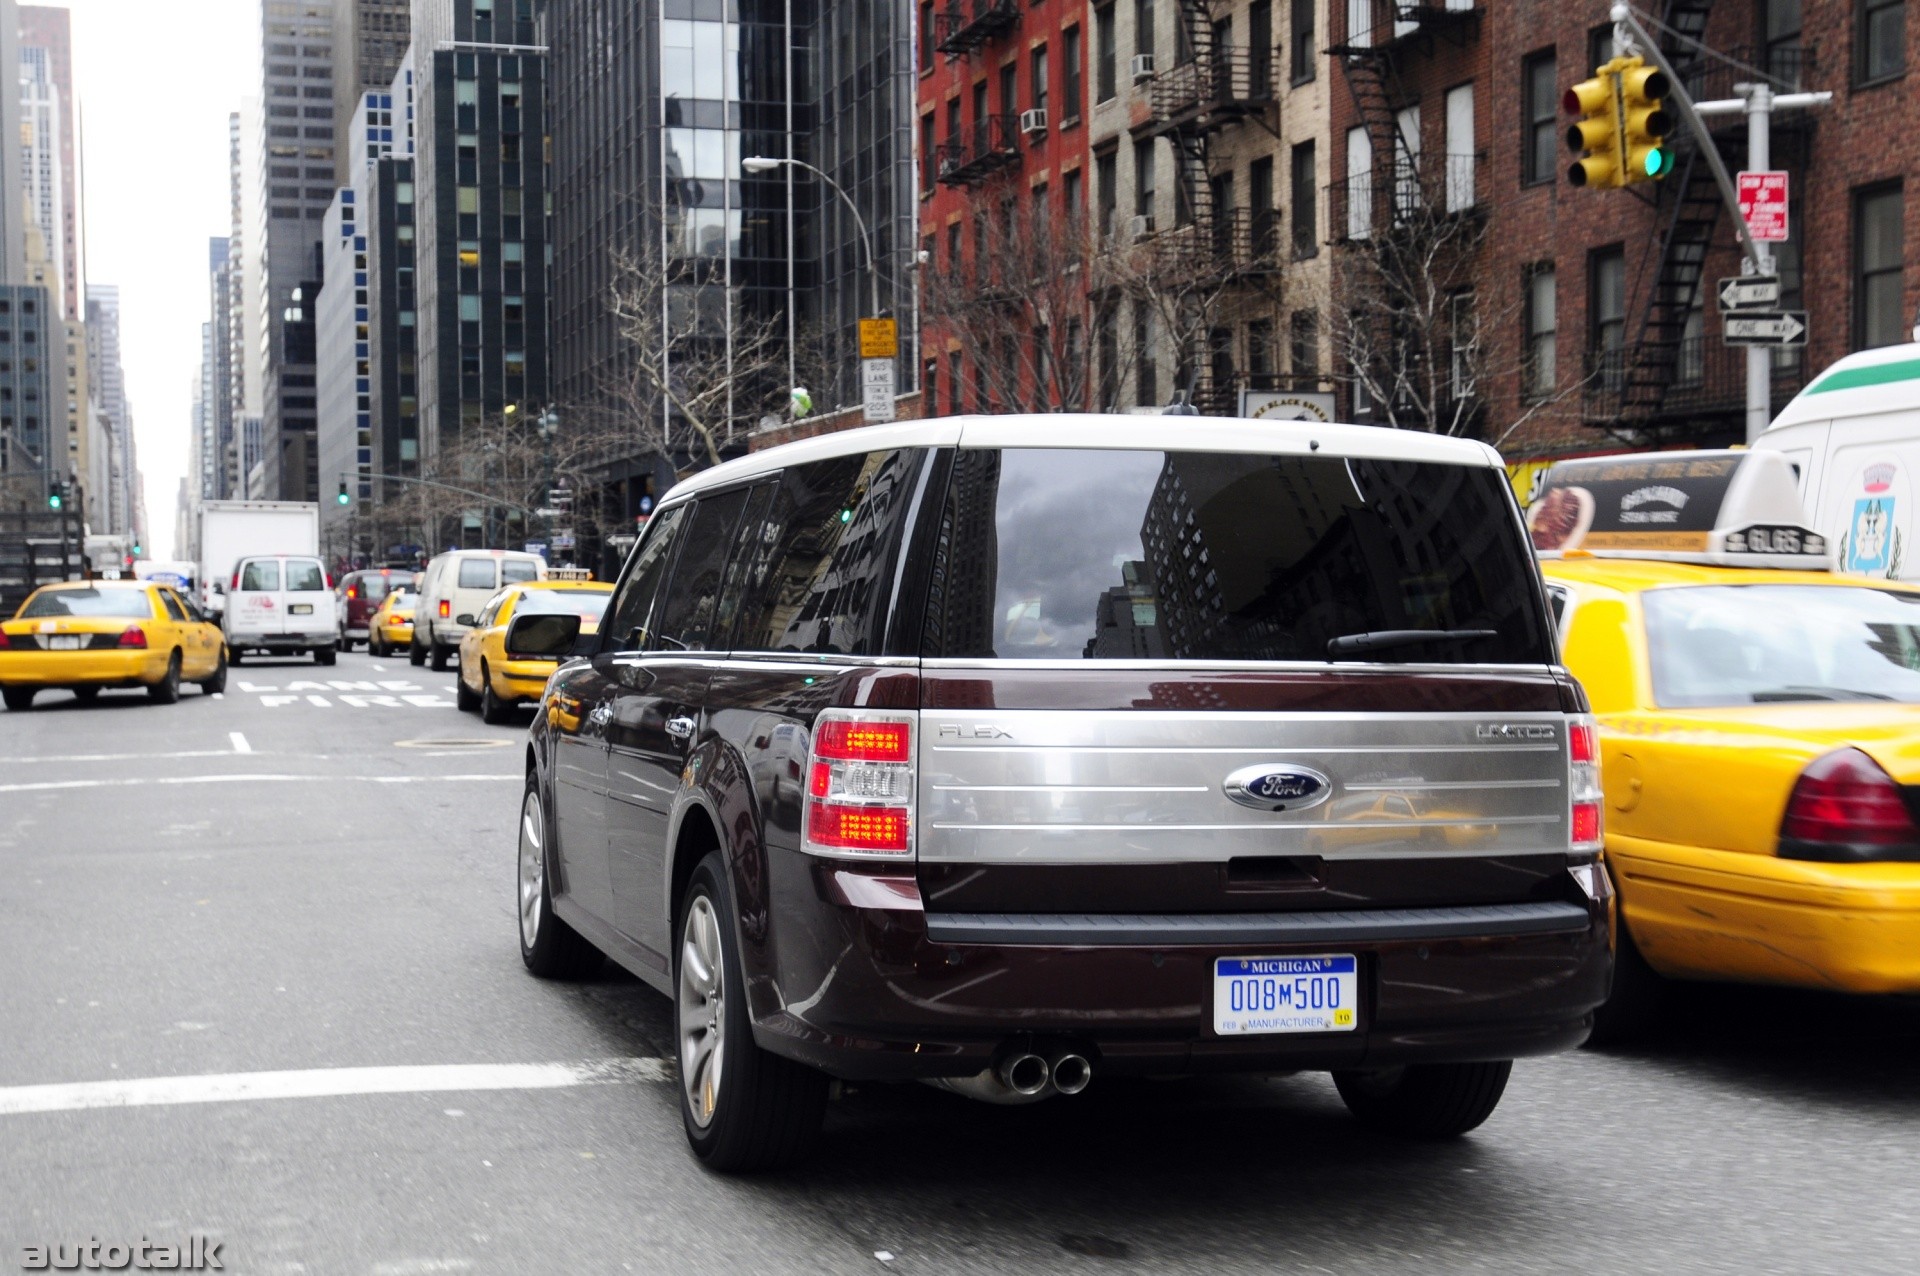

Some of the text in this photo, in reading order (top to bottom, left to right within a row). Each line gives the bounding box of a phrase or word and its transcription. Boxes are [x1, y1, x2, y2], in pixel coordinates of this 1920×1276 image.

[1753, 286, 1770, 298] WAY
[1735, 320, 1795, 334] ONE WAY
[870, 362, 886, 371] BUS
[868, 373, 888, 383] LANE
[1267, 399, 1299, 409] BLACK
[236, 680, 423, 693] LANE
[259, 694, 458, 708] FIRE
[939, 723, 1014, 739] FLEX
[1476, 723, 1556, 739] LIMITED
[1261, 774, 1306, 796] Ford
[1251, 960, 1321, 974] MICHIGAN
[1231, 977, 1340, 1012] 008M500
[1222, 1016, 1324, 1030] FEB MANUFACTURER
[1338, 1014, 1350, 1022] 10
